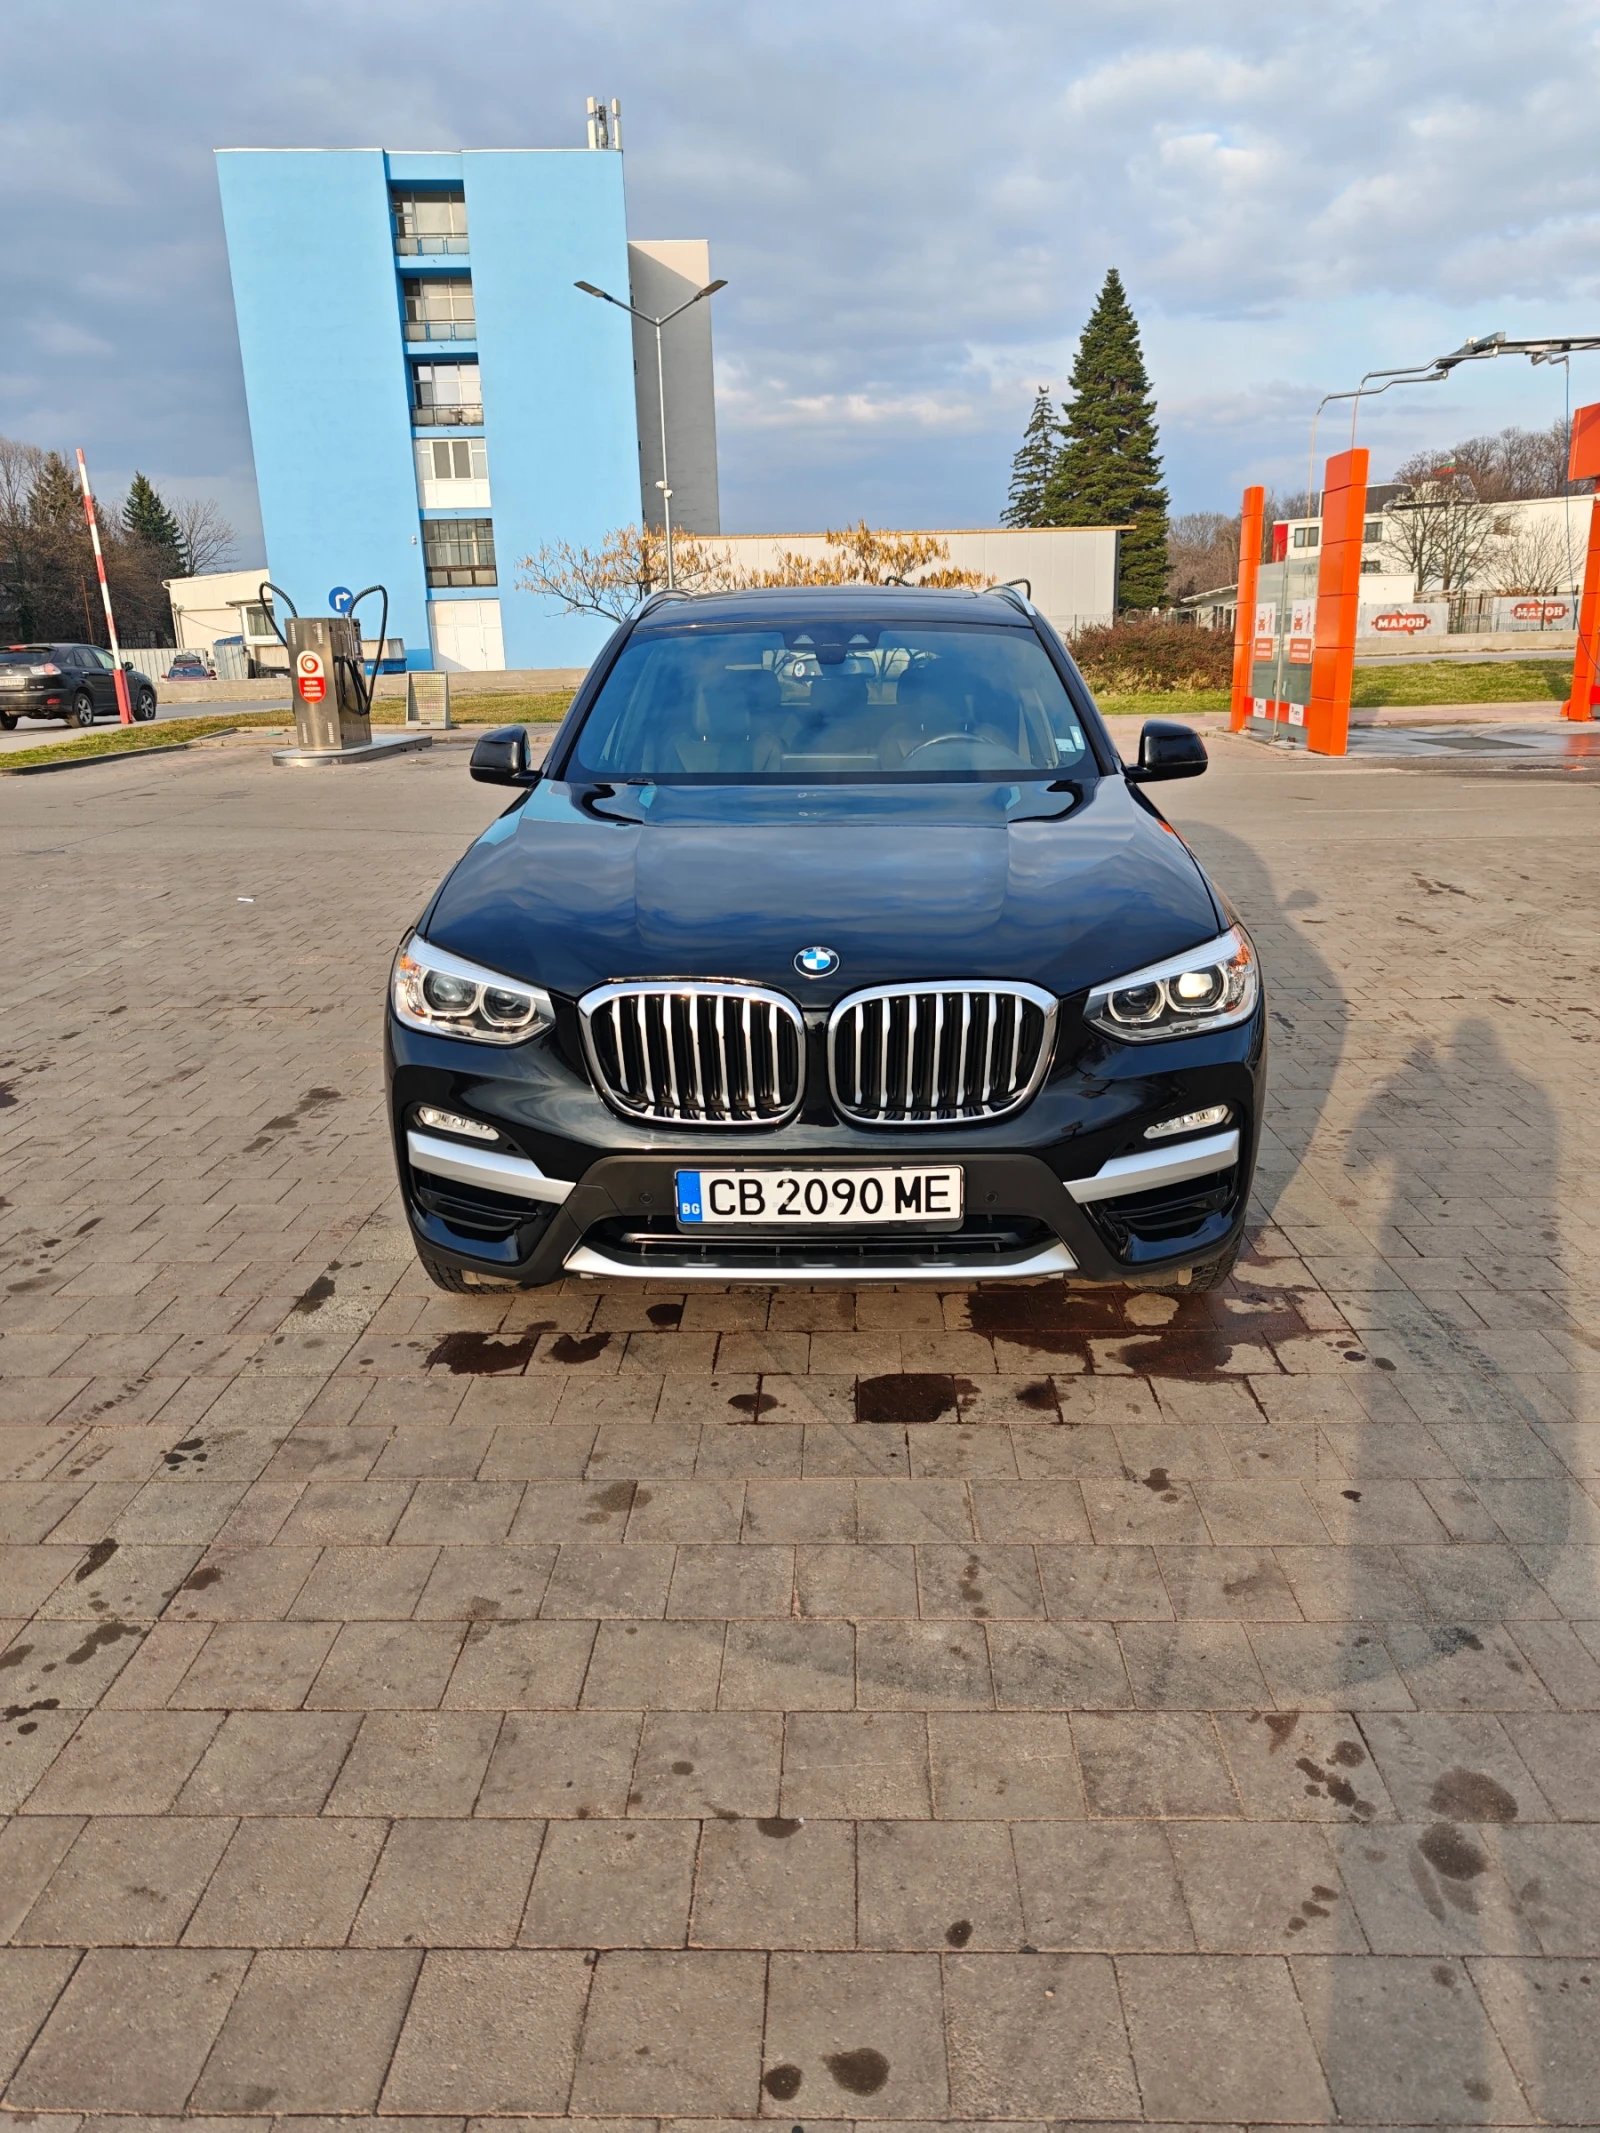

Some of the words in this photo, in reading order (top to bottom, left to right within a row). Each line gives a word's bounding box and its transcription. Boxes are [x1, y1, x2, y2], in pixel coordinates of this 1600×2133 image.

[1377, 617, 1425, 629] МАРОН
[708, 1177, 767, 1216] CB
[776, 1176, 884, 1216] 2090
[894, 1174, 952, 1214] ME
[682, 1202, 701, 1215] BG
